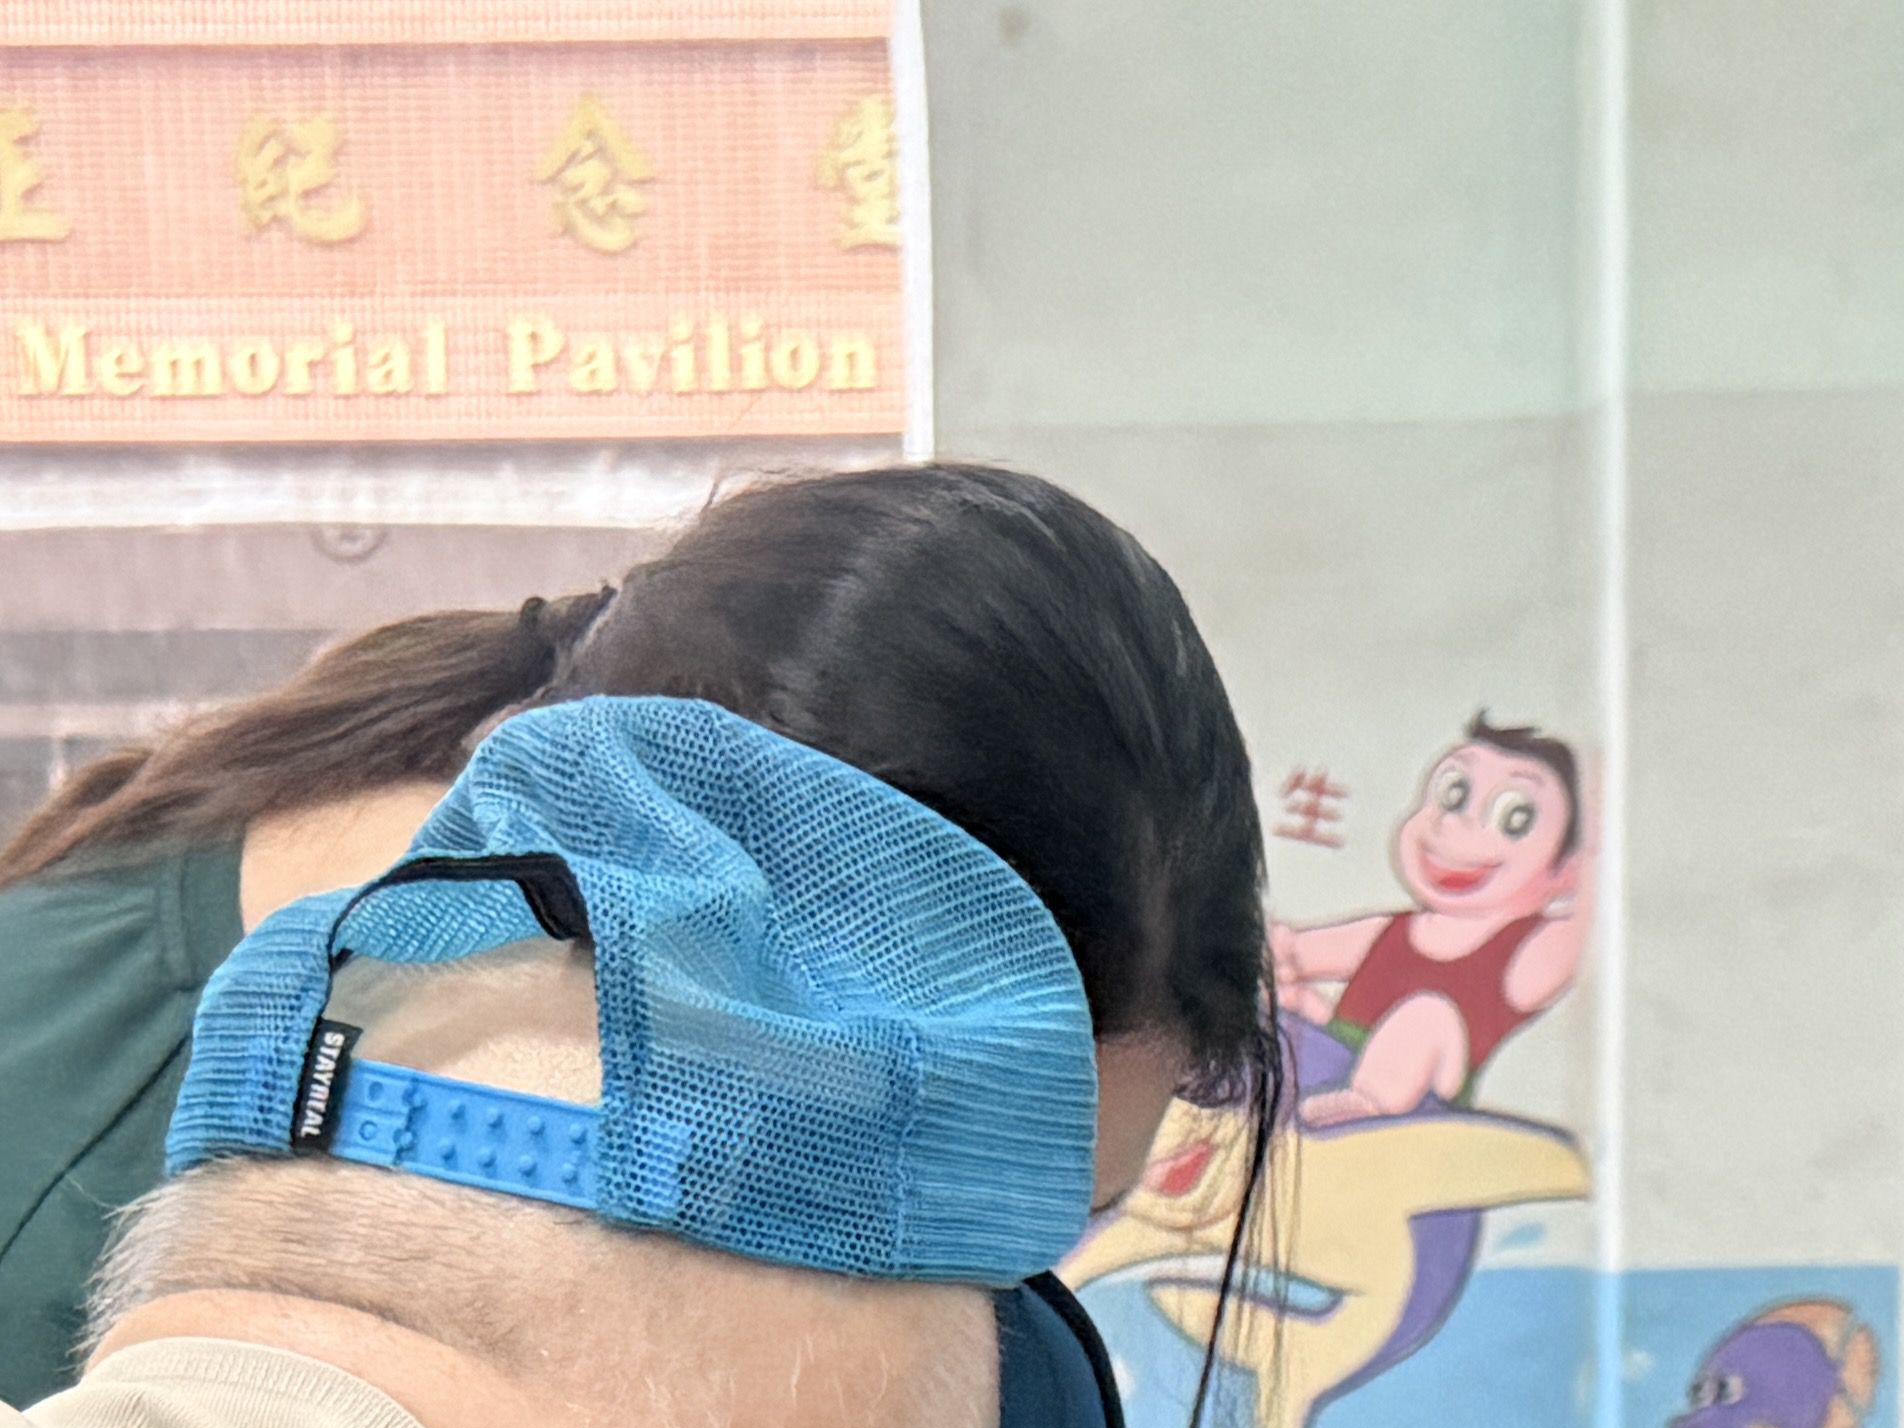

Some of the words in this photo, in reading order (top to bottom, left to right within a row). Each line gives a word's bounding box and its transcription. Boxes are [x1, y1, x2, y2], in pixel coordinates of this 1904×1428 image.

[17, 318, 448, 400] Memorial
[506, 313, 879, 396] Pavilion
[1274, 770, 1348, 850] 生
